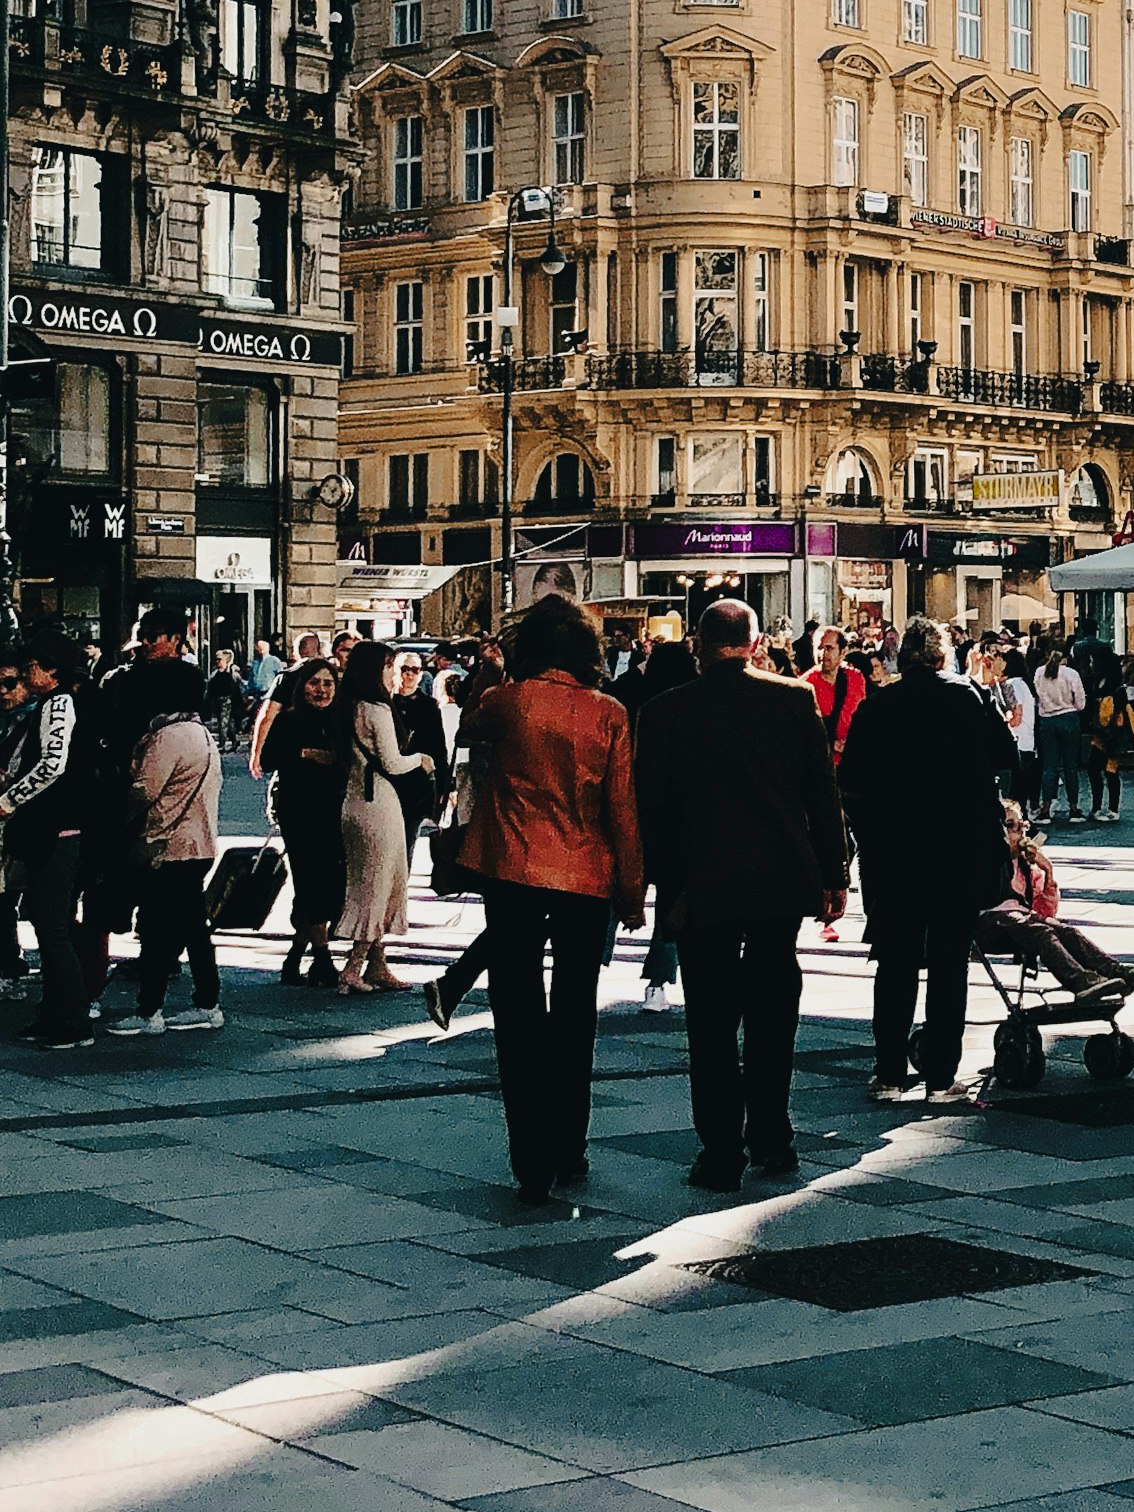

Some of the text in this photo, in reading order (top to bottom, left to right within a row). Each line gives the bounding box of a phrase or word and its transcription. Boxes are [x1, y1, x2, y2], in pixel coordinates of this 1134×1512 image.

[40, 303, 126, 334] OMEGA
[210, 330, 284, 358] OMEGA
[684, 529, 753, 546] Marionnaud
